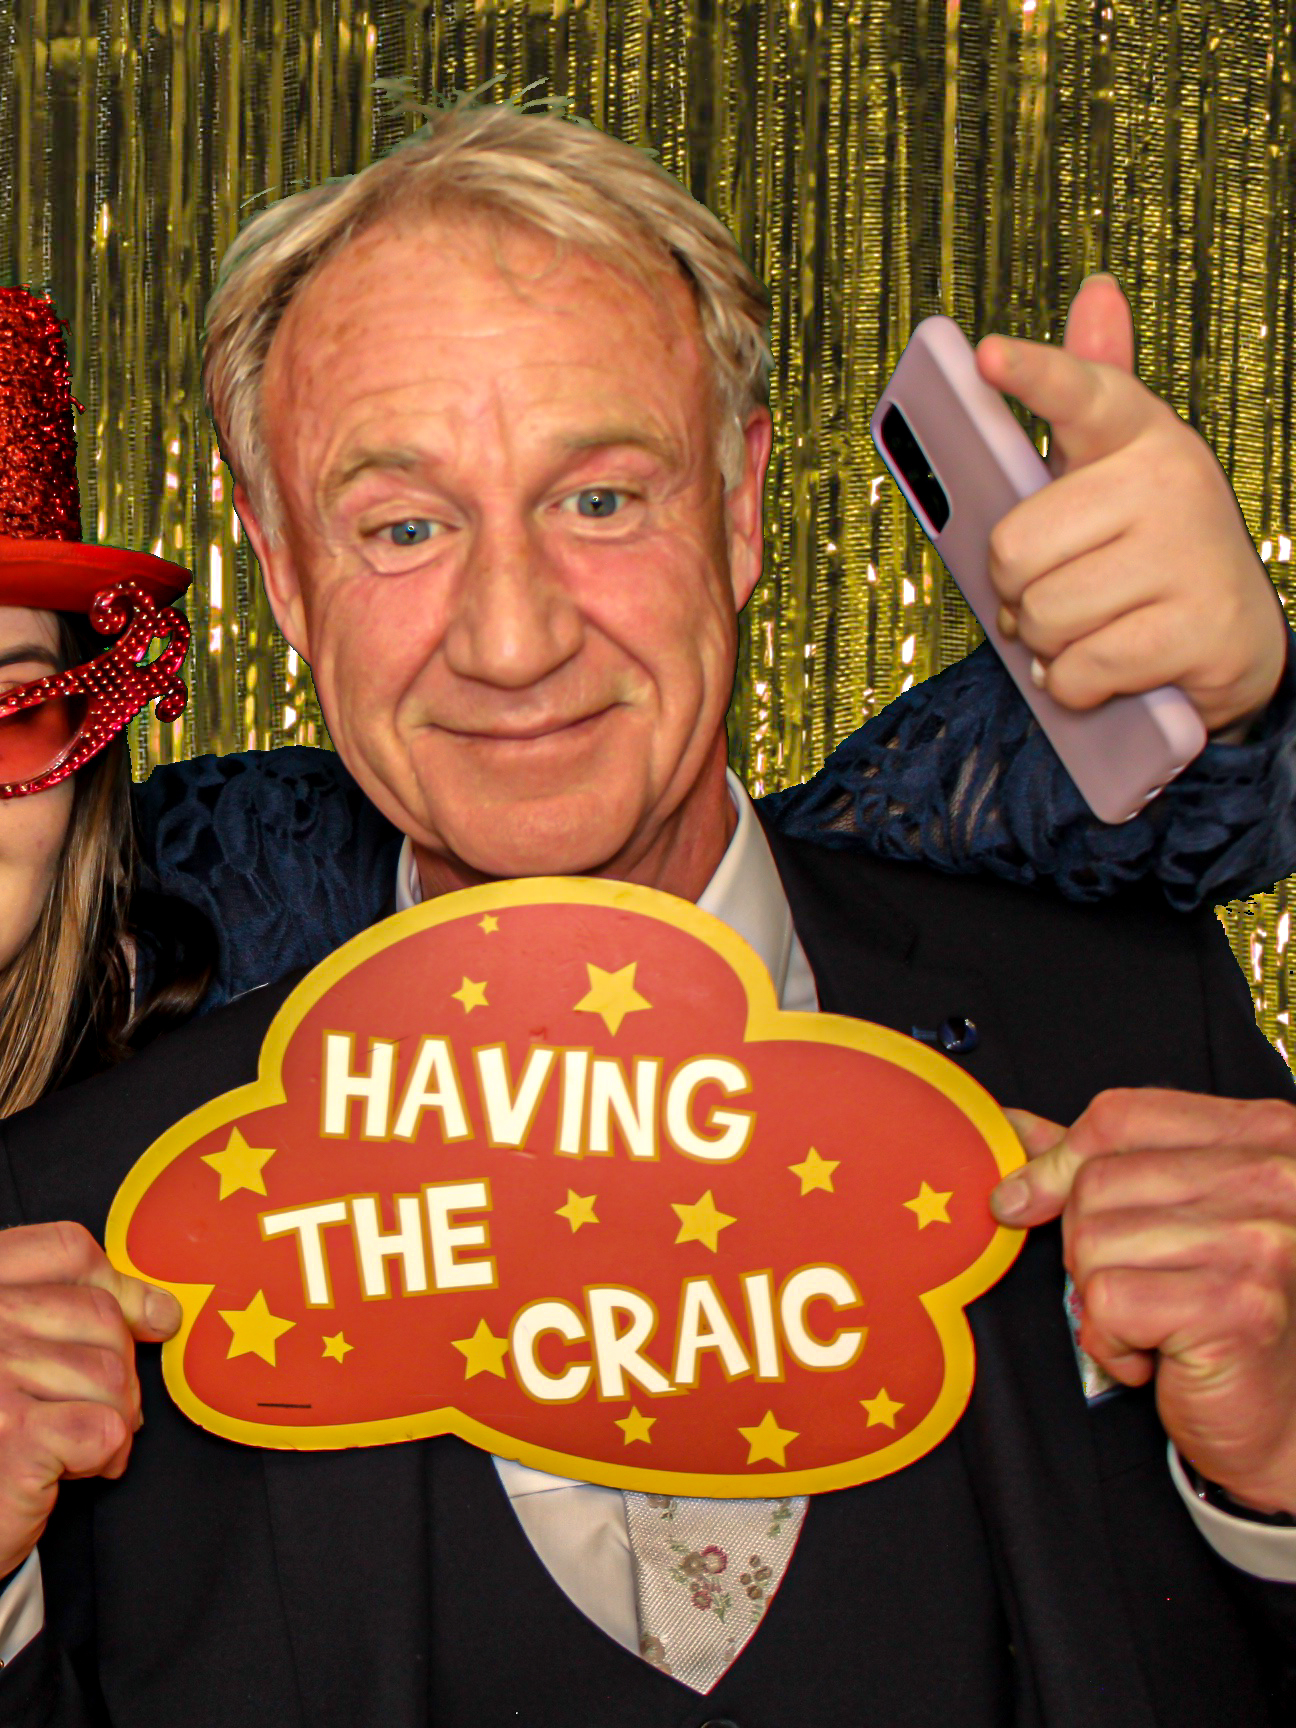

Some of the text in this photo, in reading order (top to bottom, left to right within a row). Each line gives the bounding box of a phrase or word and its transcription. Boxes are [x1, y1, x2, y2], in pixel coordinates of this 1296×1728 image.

[321, 1031, 754, 1162] HAVING
[260, 1179, 497, 1307] THE
[509, 1264, 866, 1402] CRAIC
